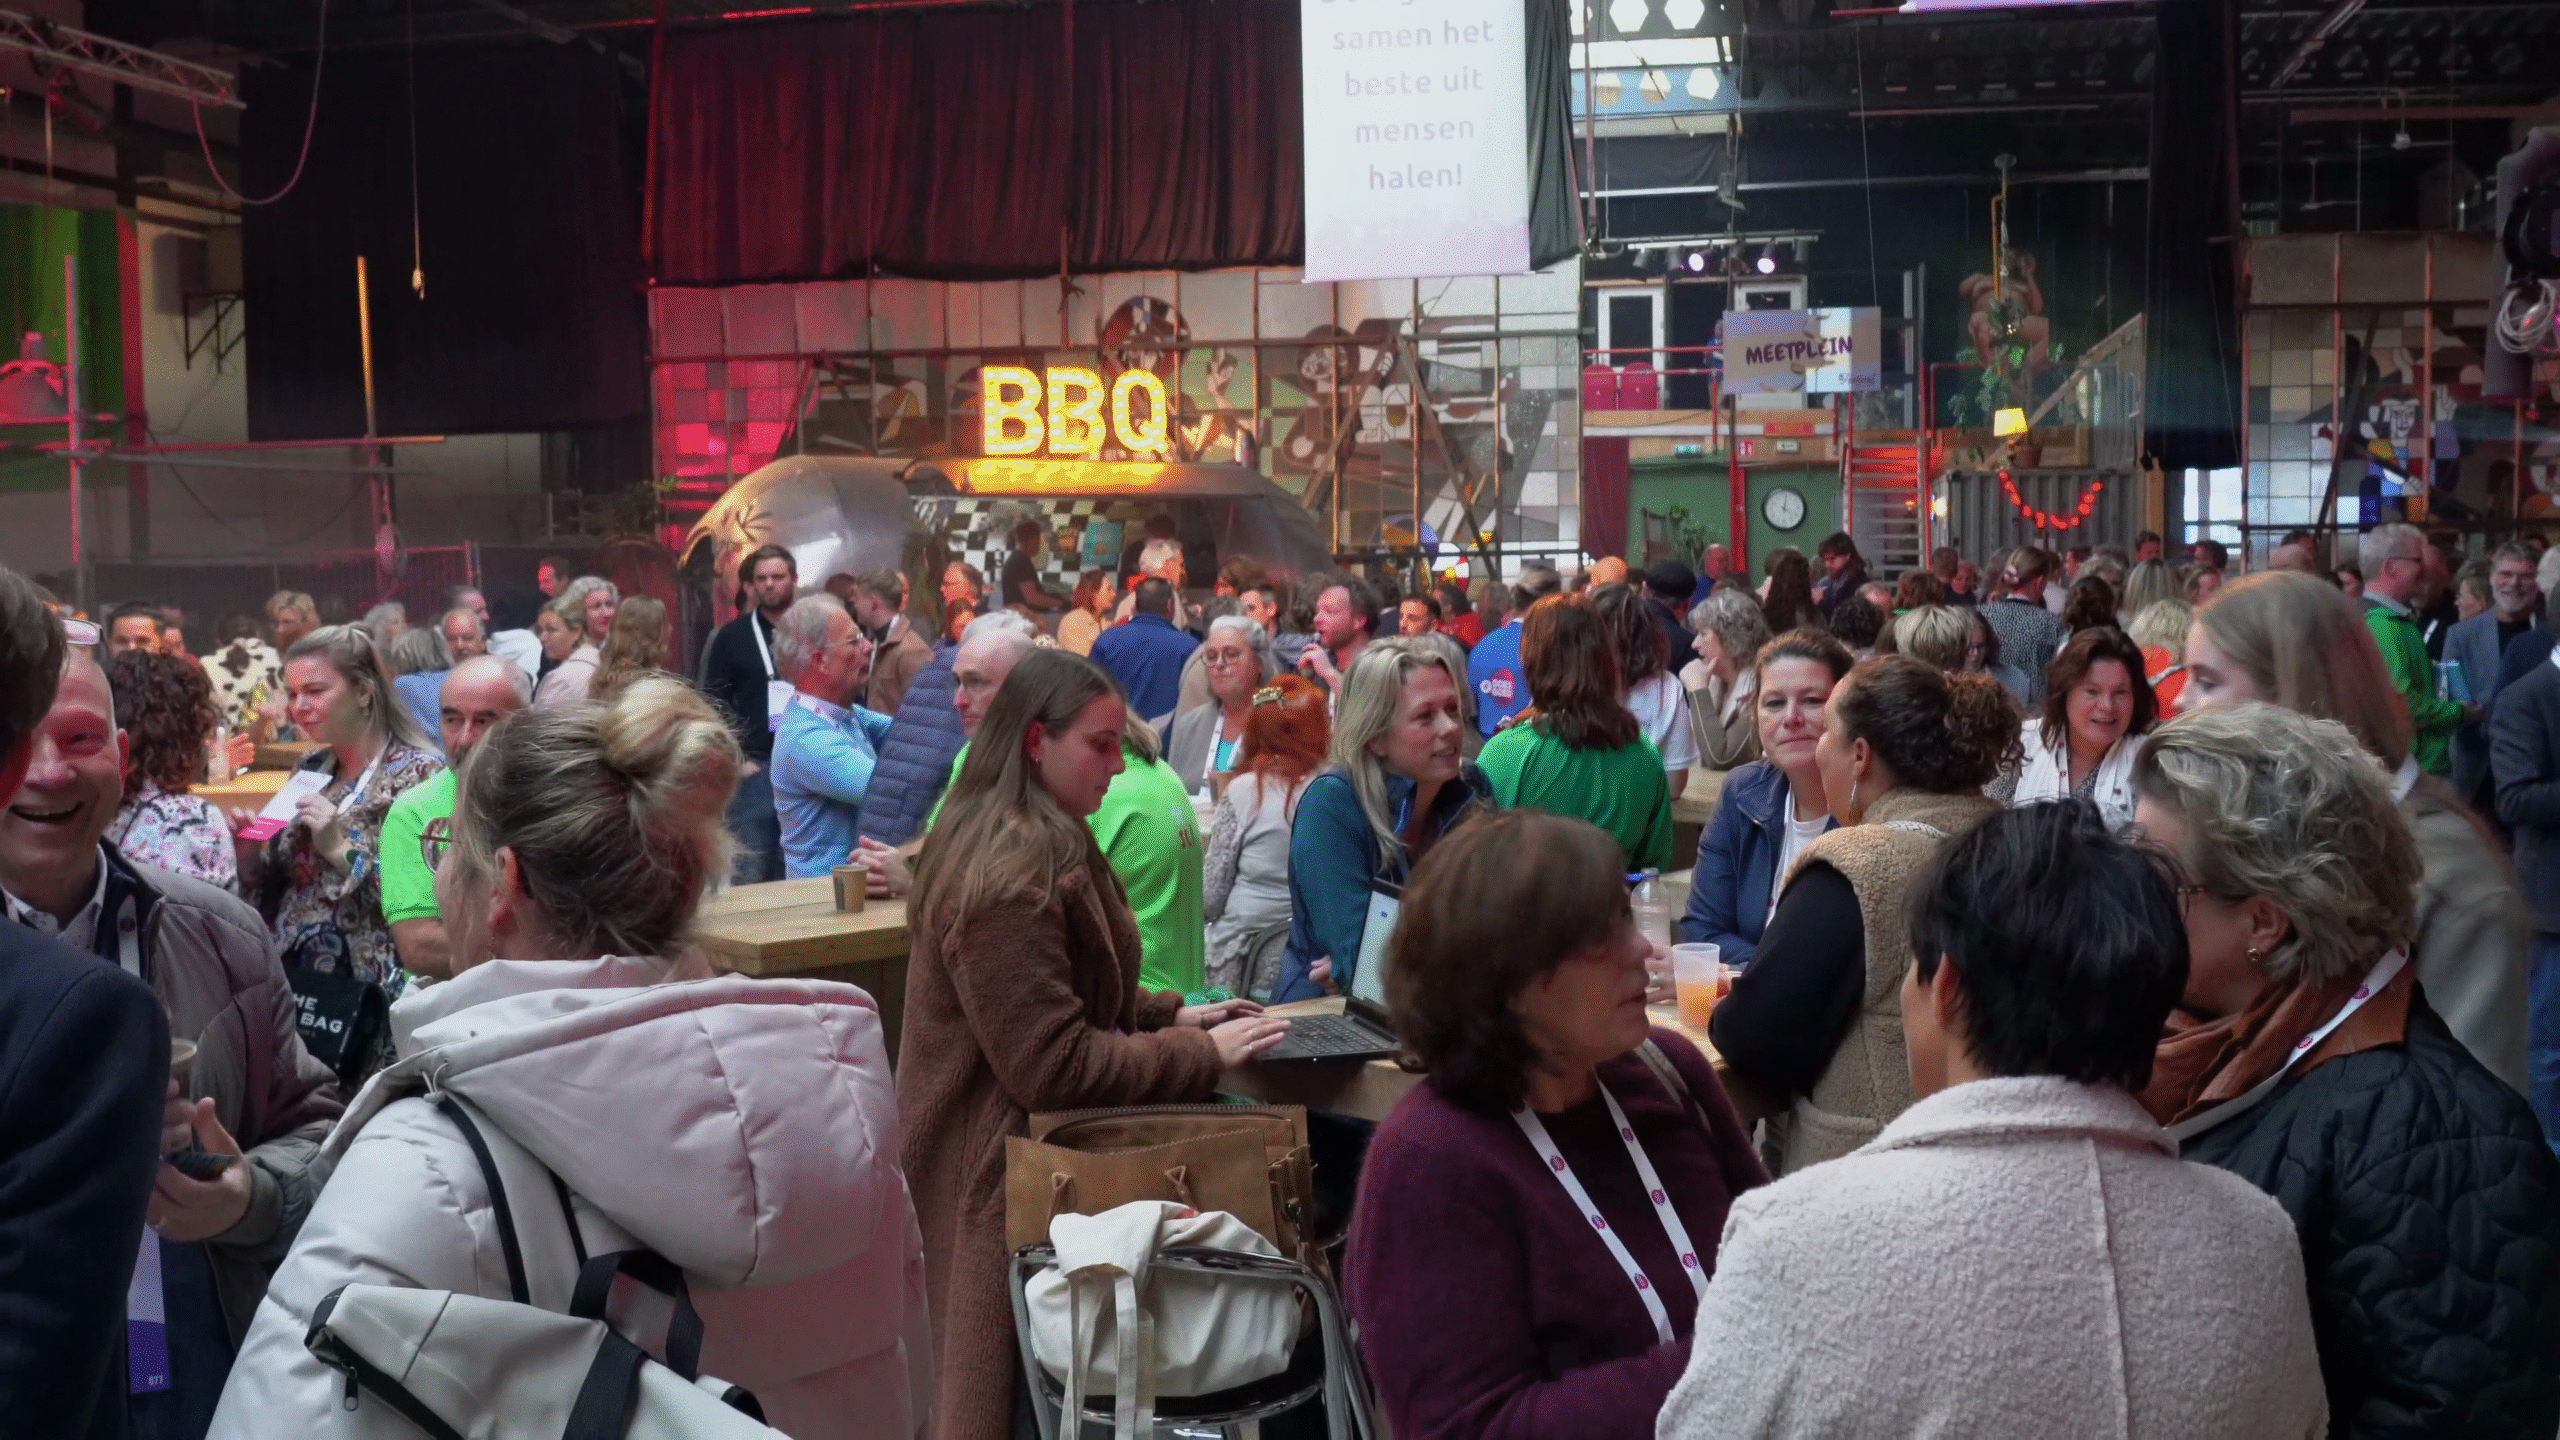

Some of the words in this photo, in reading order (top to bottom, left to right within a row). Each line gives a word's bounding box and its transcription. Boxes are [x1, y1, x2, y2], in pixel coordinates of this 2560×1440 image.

[1333, 28, 1432, 50] samen
[1443, 19, 1494, 45] het
[1345, 71, 1431, 97] beste
[1443, 65, 1483, 92] uit
[1355, 119, 1475, 143] mensen
[1369, 162, 1462, 189] halen!
[1746, 335, 1853, 365] MEETPLEIN
[984, 366, 1168, 455] BBQ
[293, 993, 318, 1010] HE
[300, 1012, 343, 1033] BAG
